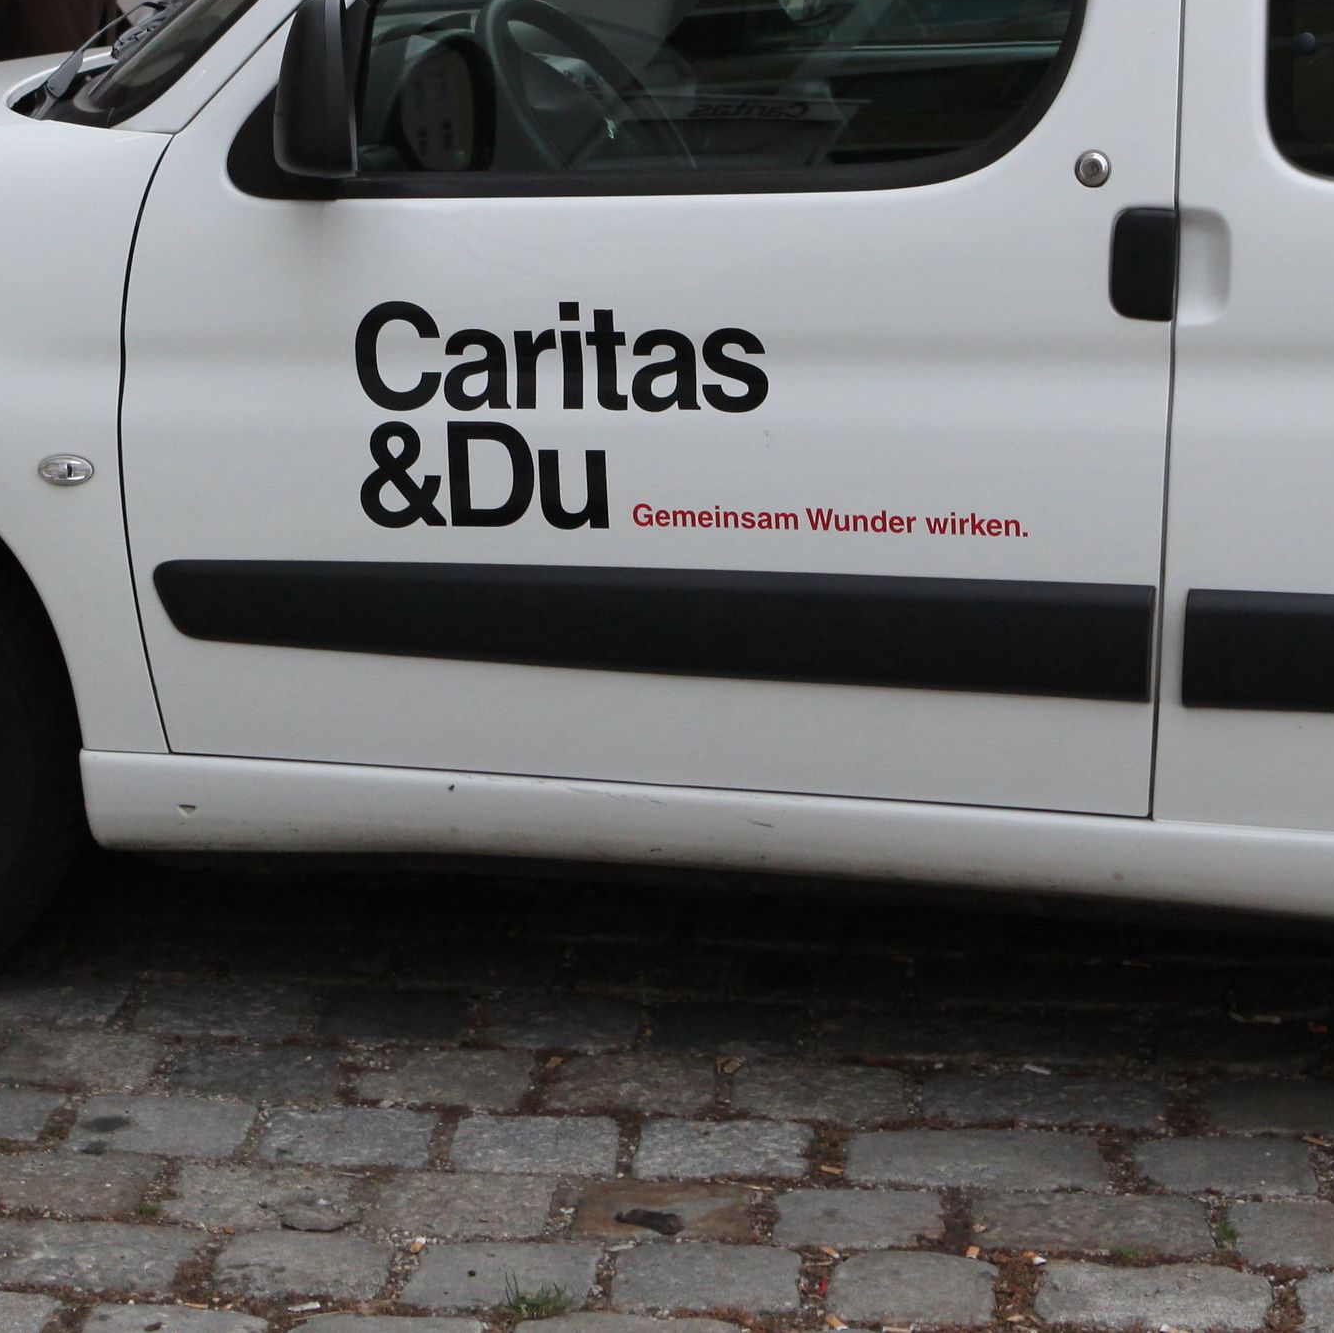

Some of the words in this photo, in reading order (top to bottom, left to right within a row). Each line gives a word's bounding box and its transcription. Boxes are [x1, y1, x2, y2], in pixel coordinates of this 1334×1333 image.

[354, 300, 769, 413] Caritas
[360, 421, 610, 530] &Du
[631, 502, 800, 531] Gemeinsam
[805, 507, 917, 535] Wunder
[925, 512, 1029, 539] wirken.
